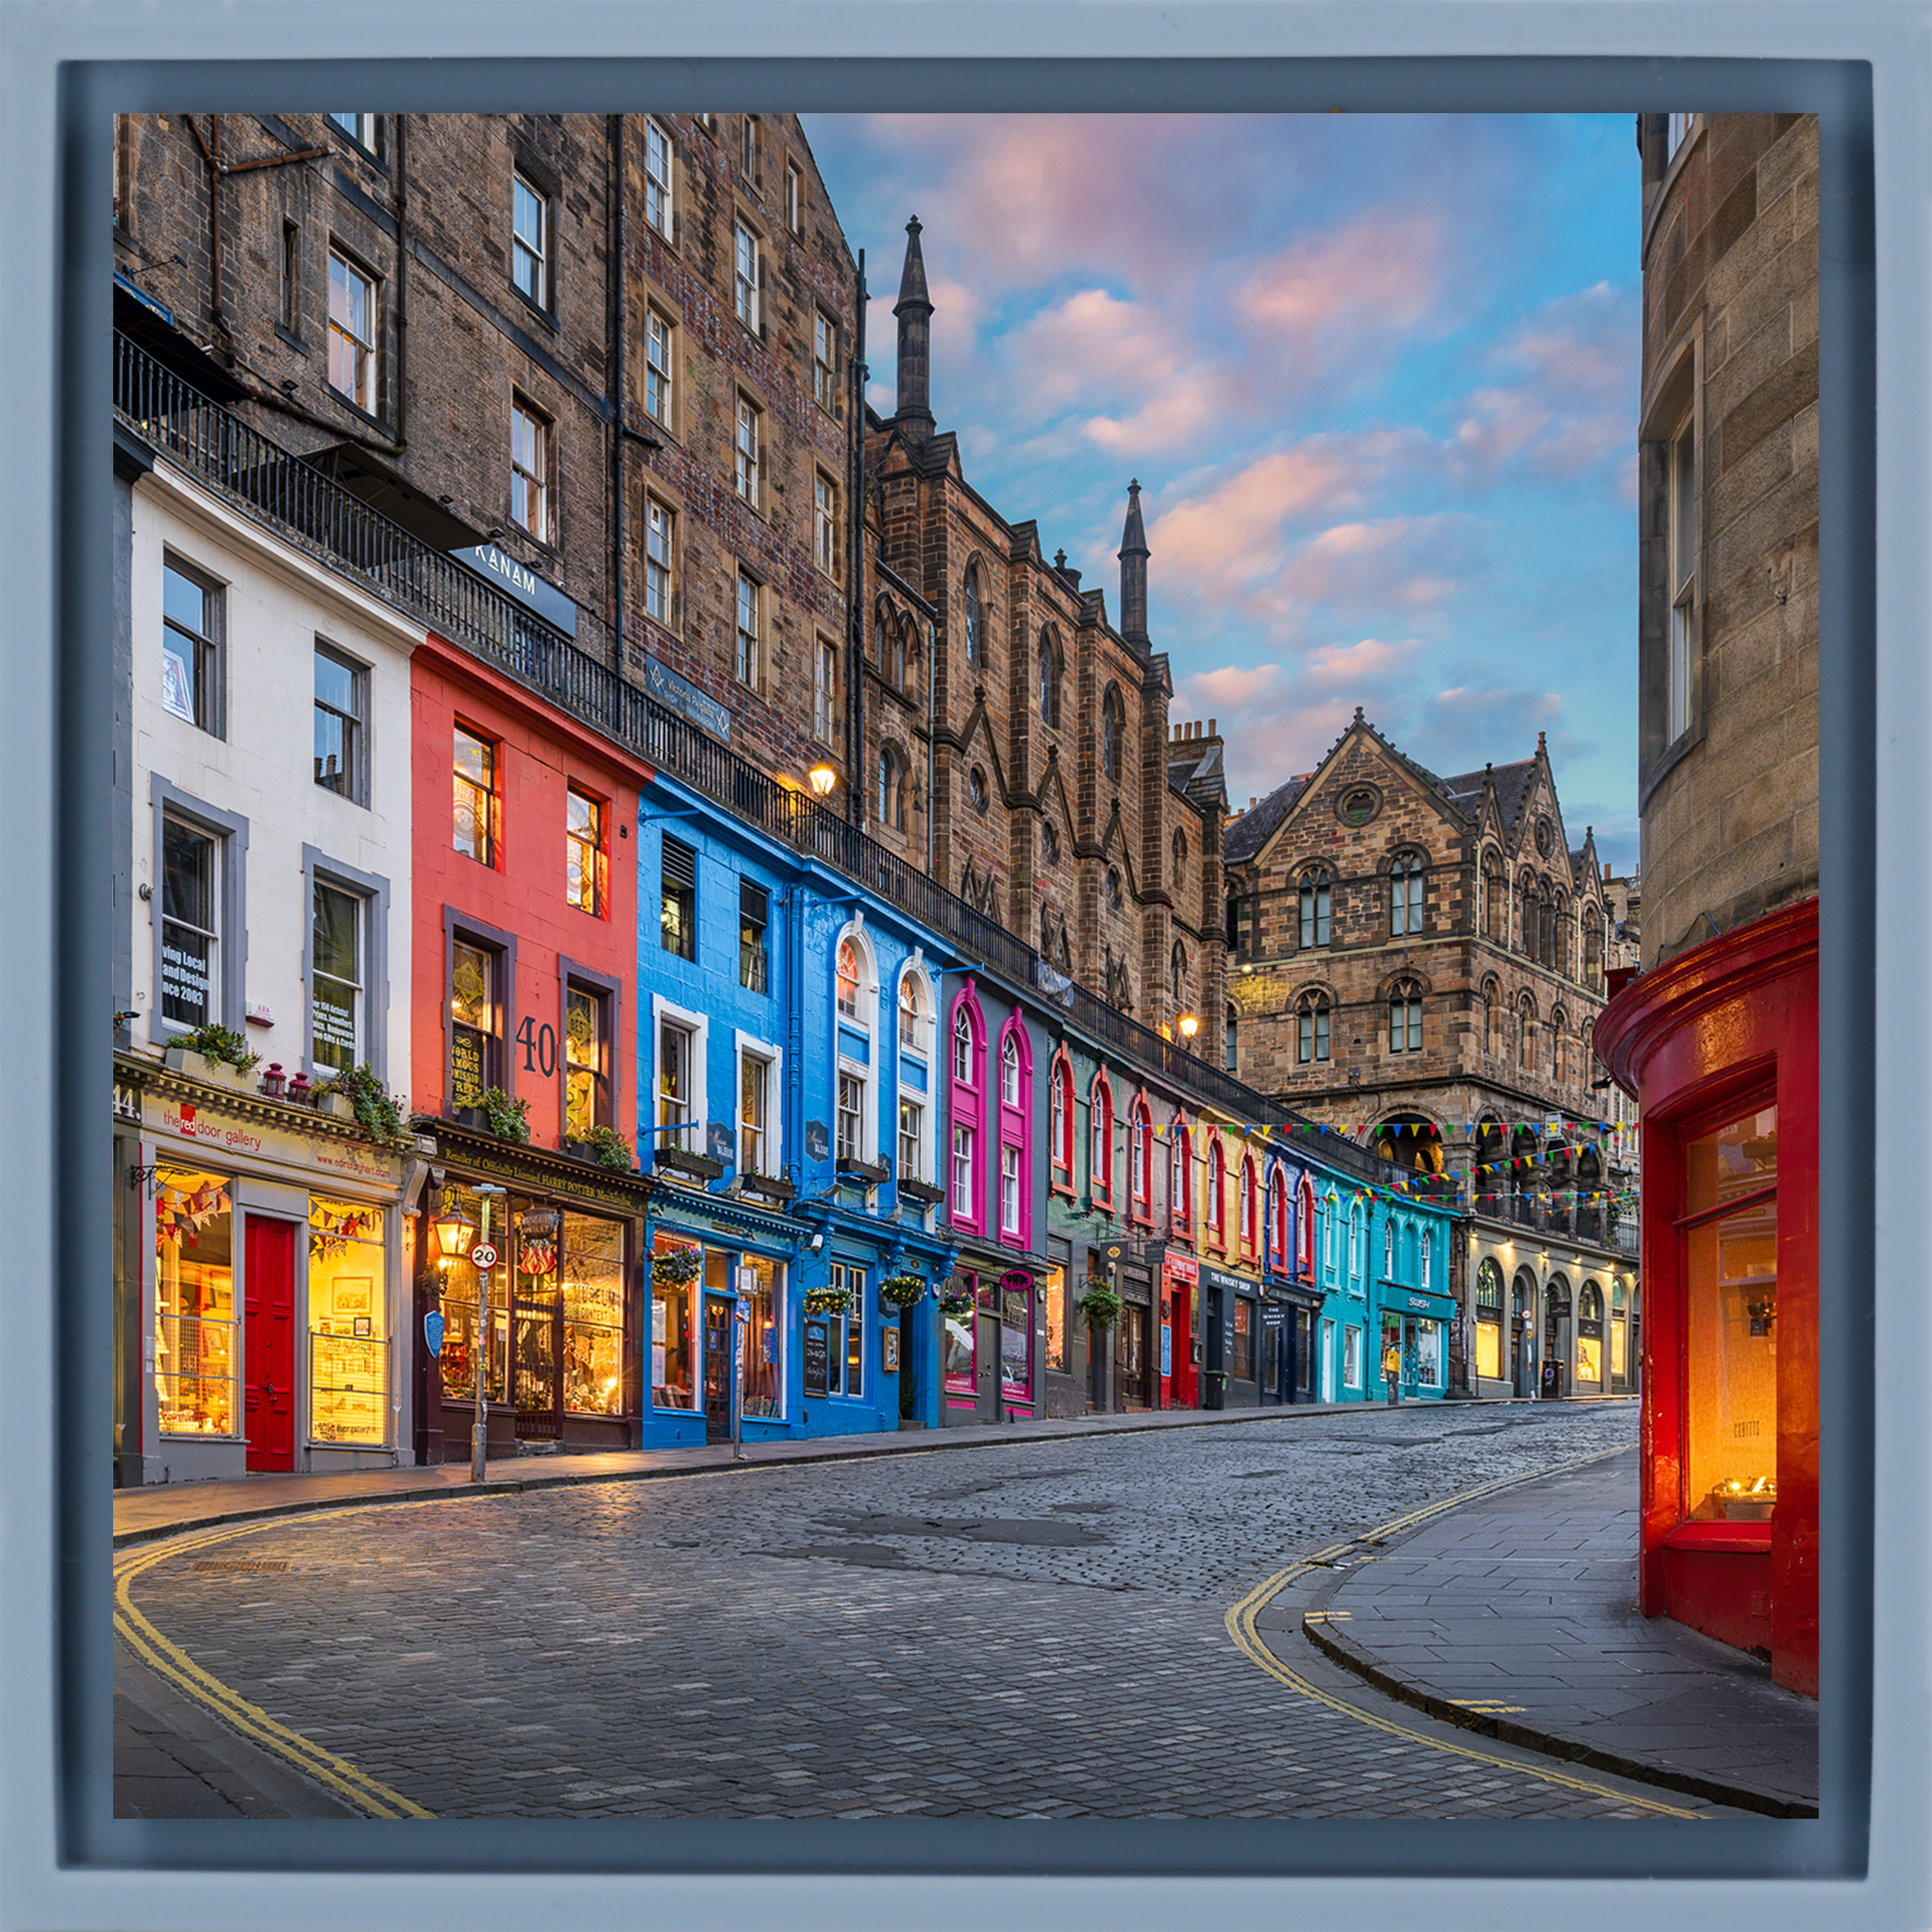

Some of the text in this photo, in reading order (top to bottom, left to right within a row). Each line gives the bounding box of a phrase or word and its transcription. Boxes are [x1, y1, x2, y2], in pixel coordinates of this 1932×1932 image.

[183, 951, 206, 974] Local
[180, 968, 209, 991] Design
[180, 985, 204, 1007] 2003
[570, 1018, 588, 1036] BEST
[516, 1016, 556, 1078] 40
[163, 1108, 261, 1152] the red door gallery
[717, 1143, 734, 1159] BLEUE
[814, 1142, 829, 1157] BLEUE
[445, 1148, 473, 1165] Retailer
[473, 1157, 481, 1168] of
[482, 1158, 513, 1178] Officially
[541, 1174, 567, 1190] HARRY
[567, 1181, 596, 1198] POTTER
[475, 1249, 495, 1263] 20
[1210, 1272, 1252, 1291] THE WHISKY SHOP
[1734, 1420, 1760, 1439] CUBITTS
